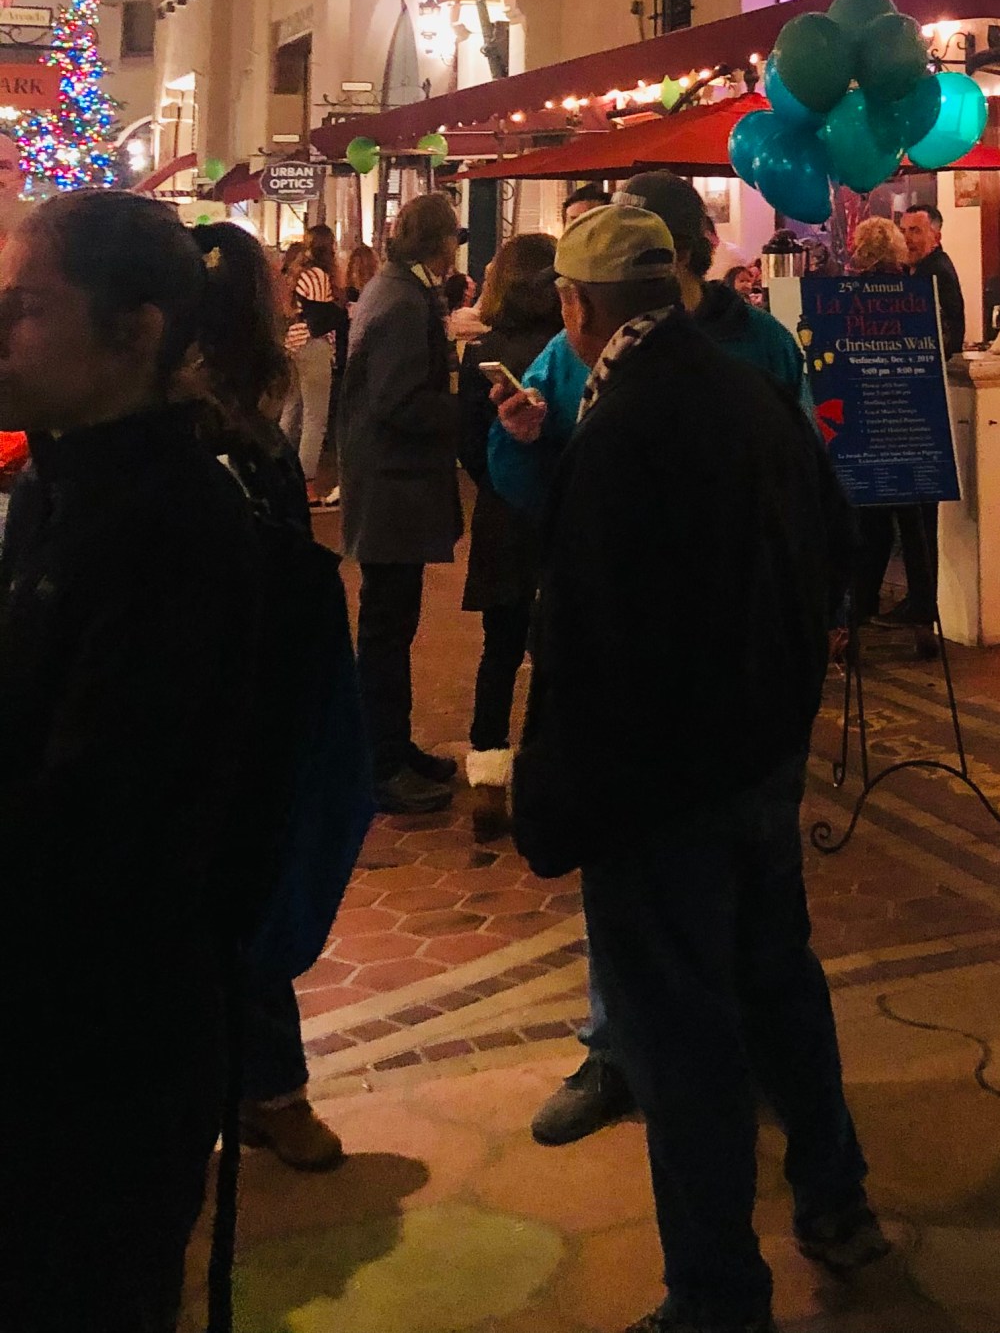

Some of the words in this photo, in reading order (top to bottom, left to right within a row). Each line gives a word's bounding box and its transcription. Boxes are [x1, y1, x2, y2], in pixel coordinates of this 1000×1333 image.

[270, 167, 314, 177] URBAN
[269, 178, 314, 189] OPTICS
[838, 281, 860, 293] 25th
[863, 281, 904, 293] Annual
[816, 294, 842, 315] La
[852, 292, 928, 314] Arcada
[845, 315, 903, 337] Plaza
[835, 338, 902, 352] Christmas
[903, 336, 937, 350] Walk
[917, 355, 934, 363] 2019
